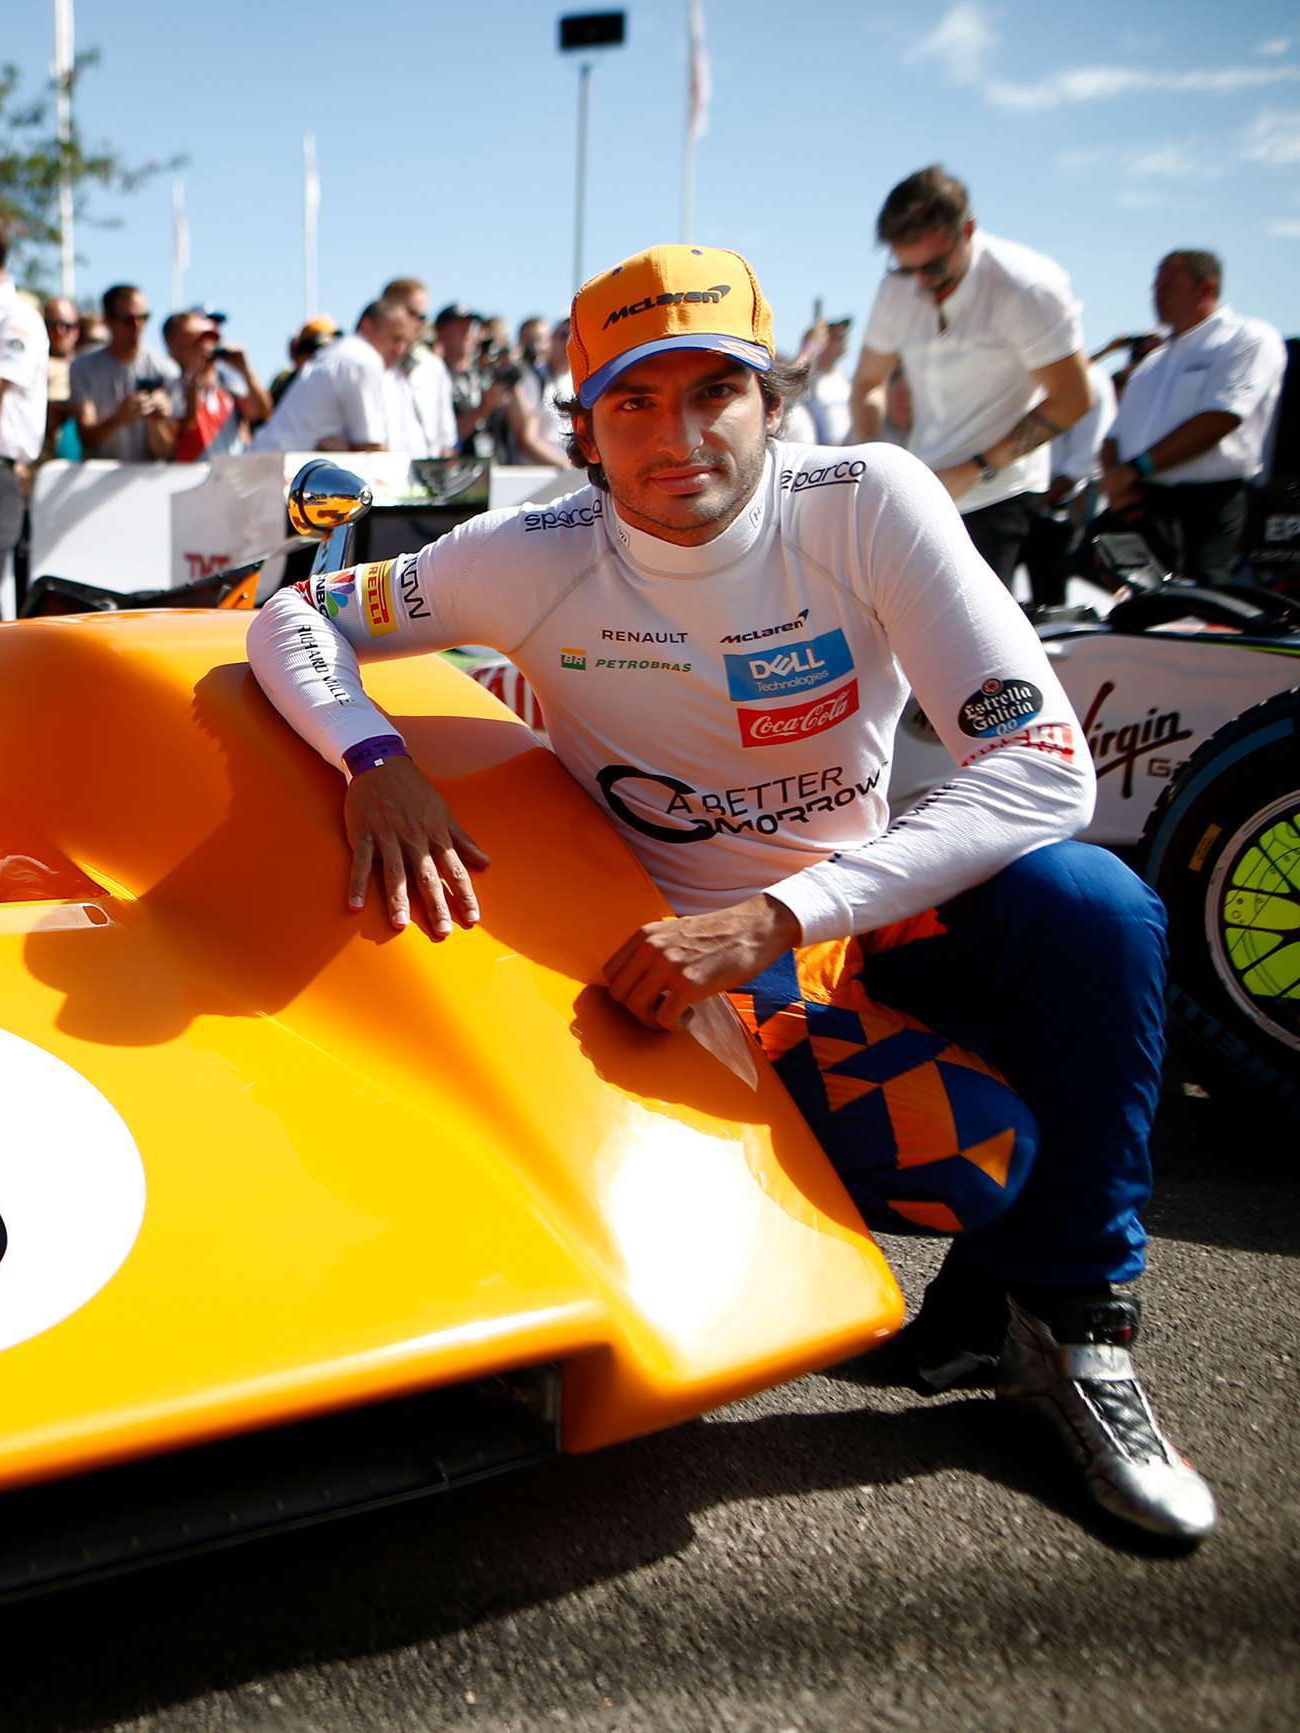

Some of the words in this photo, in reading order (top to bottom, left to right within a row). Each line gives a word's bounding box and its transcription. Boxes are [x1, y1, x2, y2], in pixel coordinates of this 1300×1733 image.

[602, 287, 724, 331] McLaren
[780, 459, 867, 493] sparco
[315, 575, 330, 619] NBC
[366, 562, 388, 625] RELLI
[601, 629, 689, 644] RENAULT
[719, 615, 806, 644] McLaren
[561, 655, 585, 666] BR
[595, 658, 693, 673] PETROBRAS
[749, 648, 826, 680] DELL
[756, 670, 829, 692] Technologies
[963, 686, 1033, 720] Estrella
[972, 701, 1035, 730] Galicia
[665, 793, 693, 815] A
[701, 766, 844, 818] BETTER
